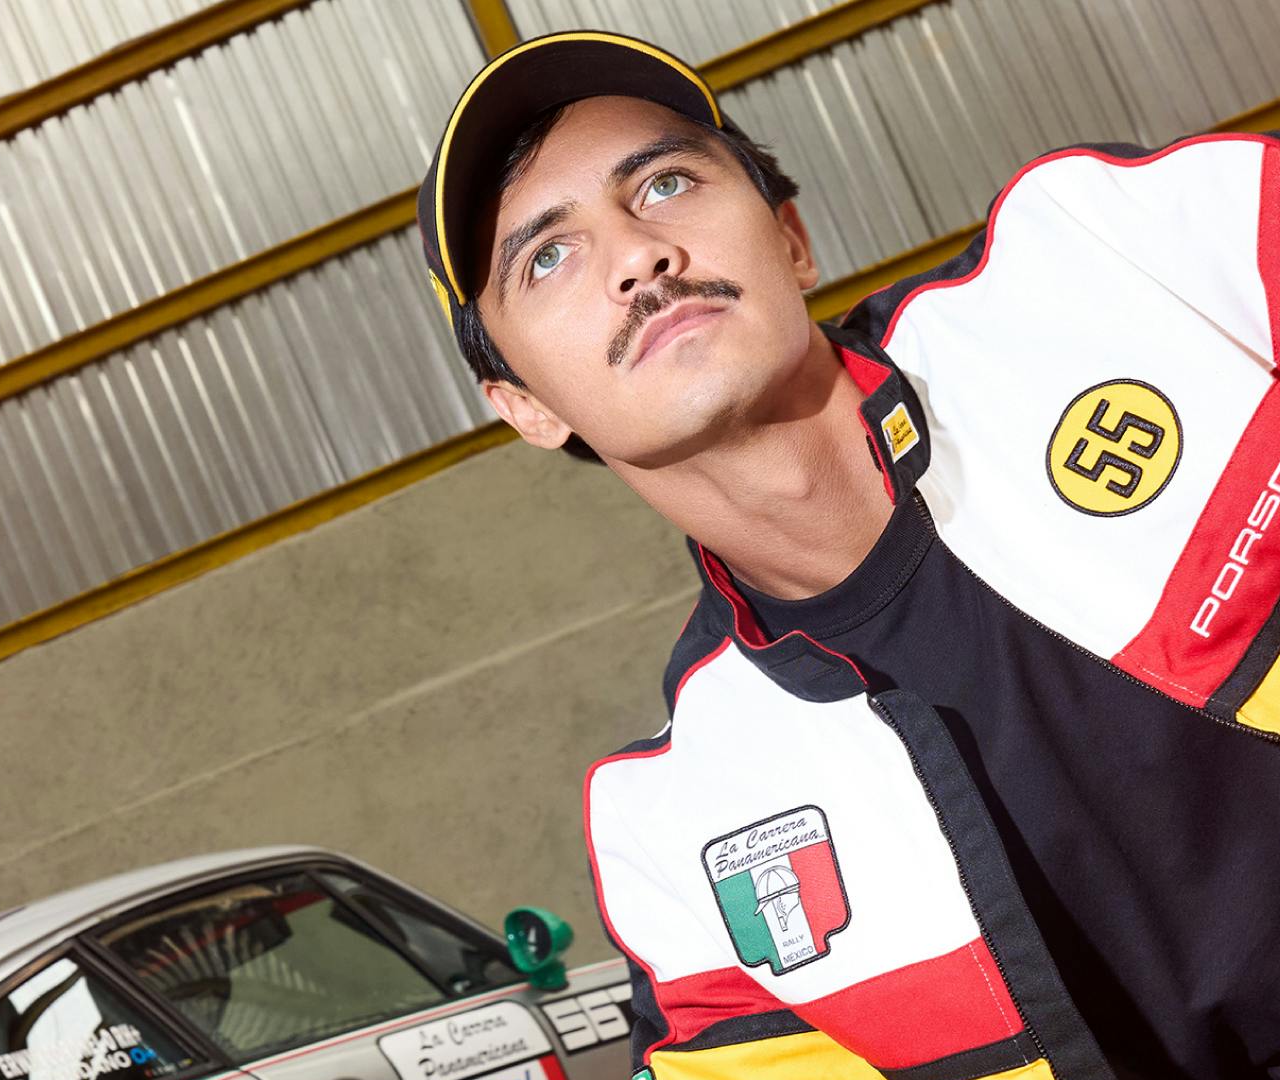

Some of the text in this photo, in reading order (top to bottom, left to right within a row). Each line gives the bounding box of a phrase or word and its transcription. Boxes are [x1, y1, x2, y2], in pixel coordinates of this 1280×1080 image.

[1063, 398, 1165, 498] 55
[715, 817, 807, 860] La Carrera
[715, 829, 819, 879] Panamericana
[782, 933, 804, 948] RALLY
[418, 1015, 508, 1050] La Carrera
